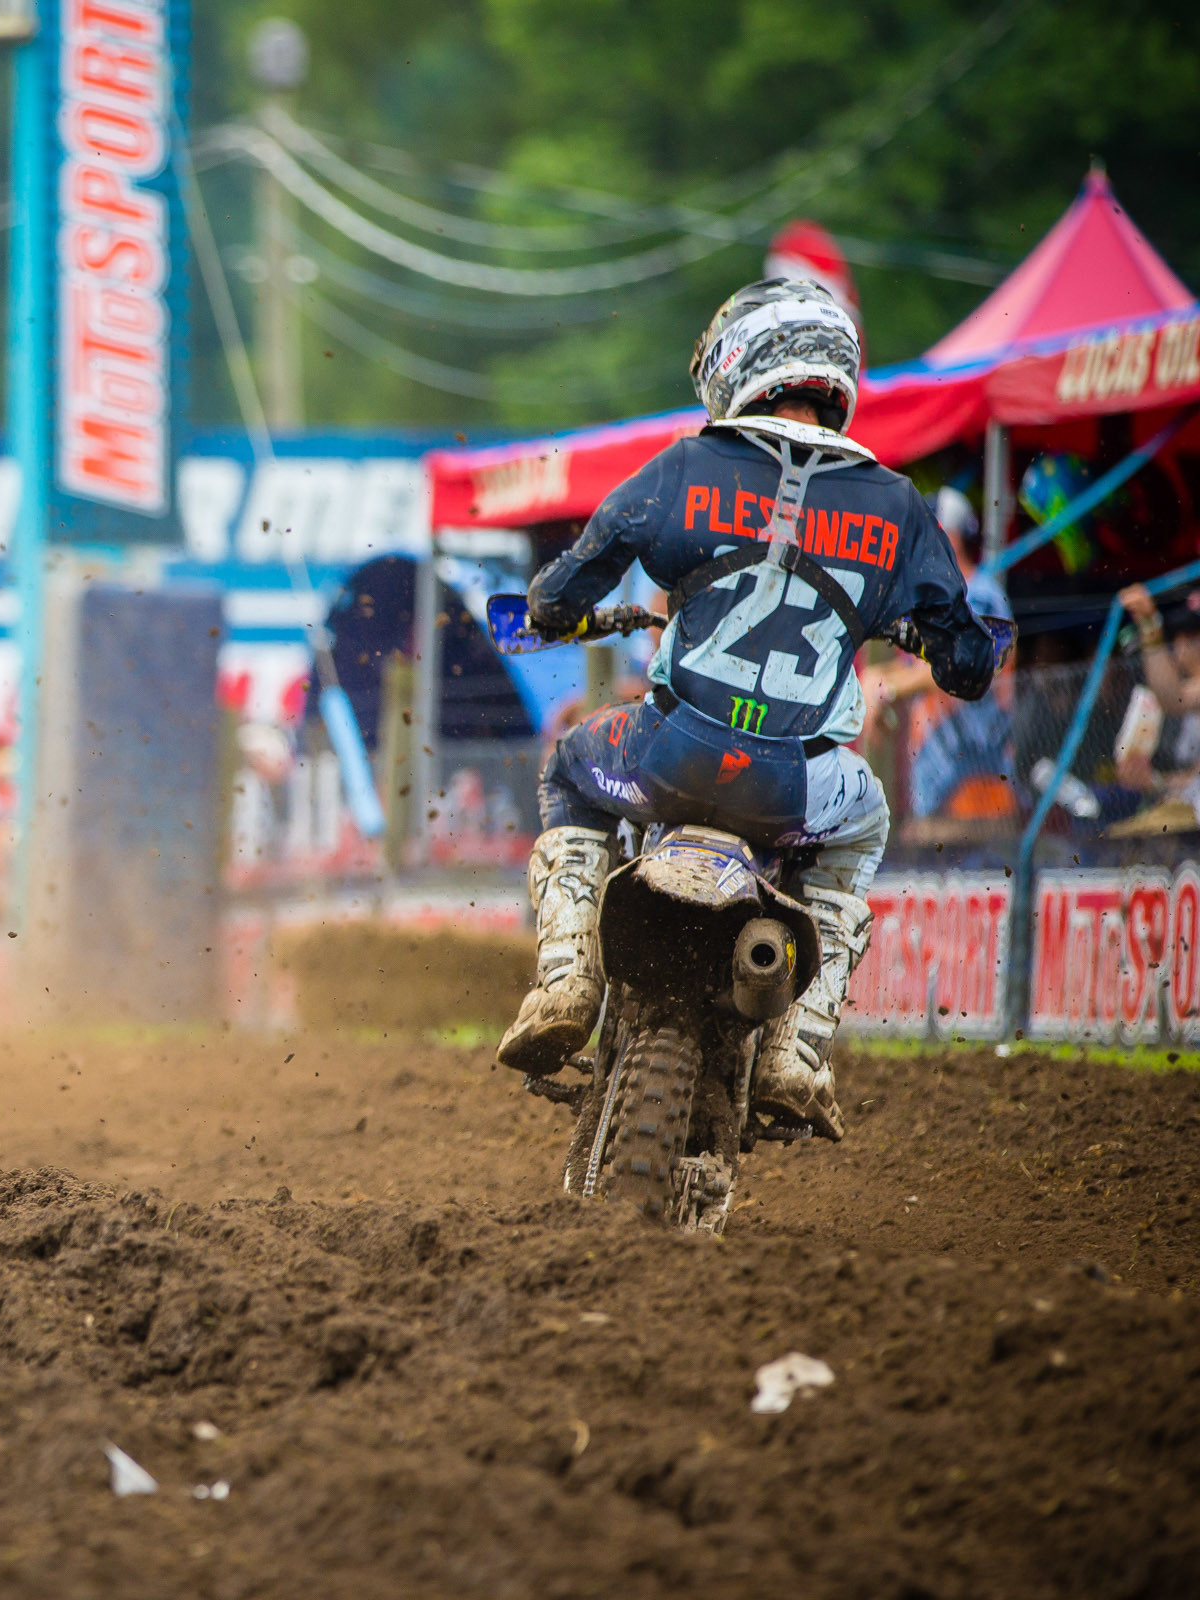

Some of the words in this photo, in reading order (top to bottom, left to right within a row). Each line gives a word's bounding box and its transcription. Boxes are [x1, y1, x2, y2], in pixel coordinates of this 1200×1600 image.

[721, 345, 745, 373] BELL
[684, 484, 899, 572] PLESSINGER
[678, 544, 866, 707] 23
